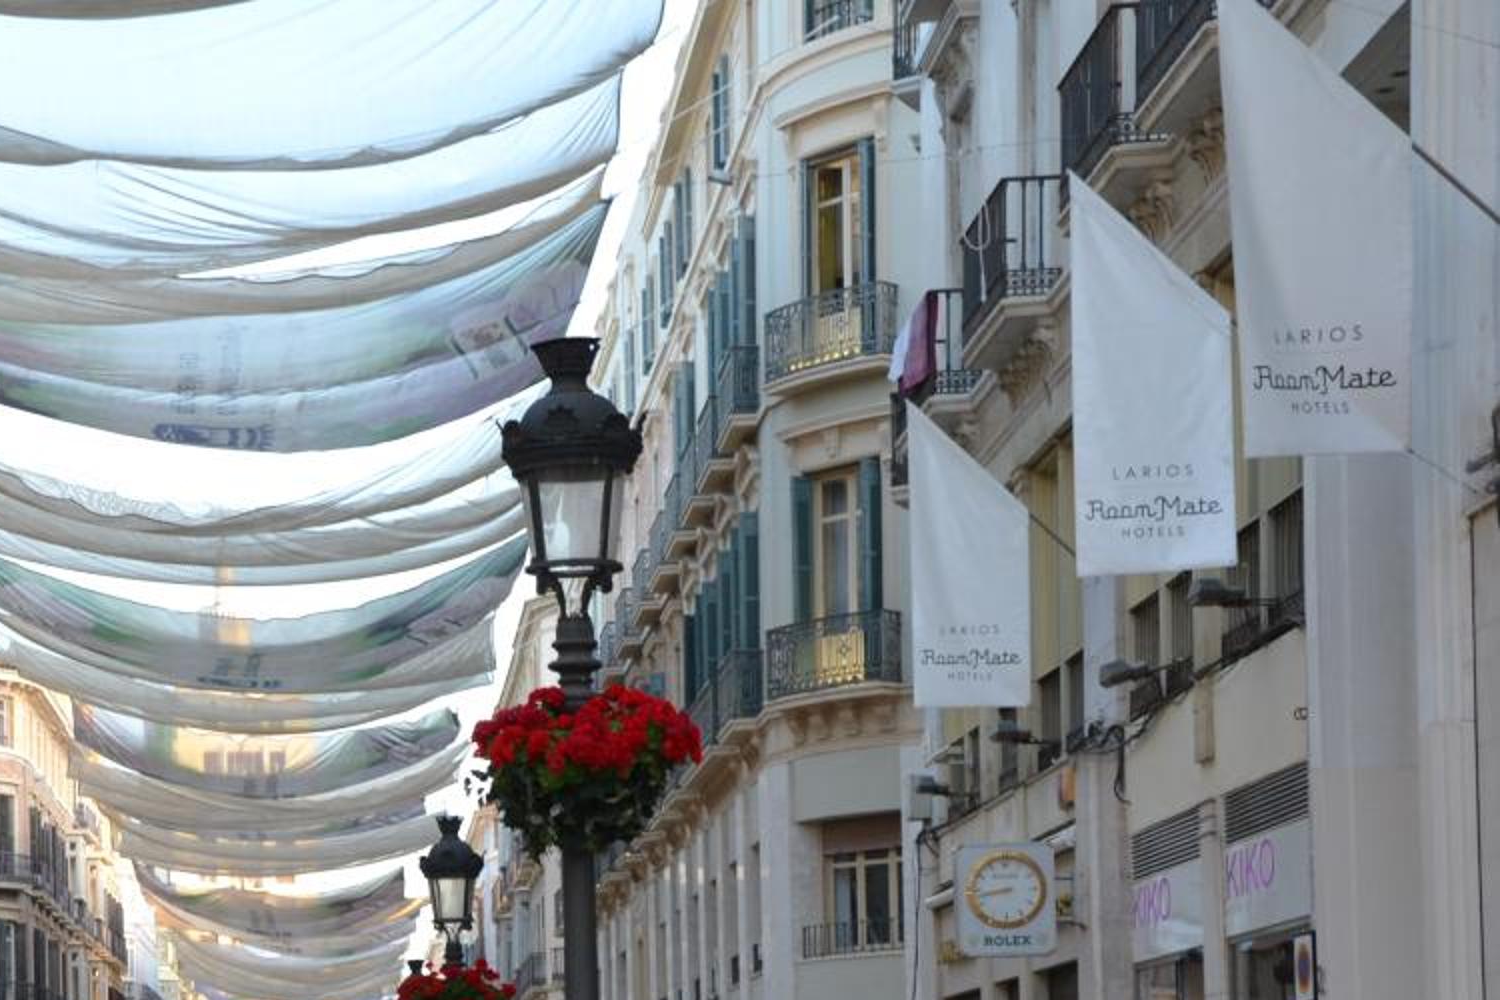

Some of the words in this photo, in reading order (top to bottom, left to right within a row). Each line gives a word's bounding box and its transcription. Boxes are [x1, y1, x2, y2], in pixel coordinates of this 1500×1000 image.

[1273, 324, 1364, 344] LARIOS
[1291, 401, 1349, 414] HOTELS
[1112, 464, 1194, 480] LARIOS
[1122, 526, 1185, 538] HOTELS
[1226, 838, 1275, 898] KIKO
[983, 934, 1032, 946] ROLEX
